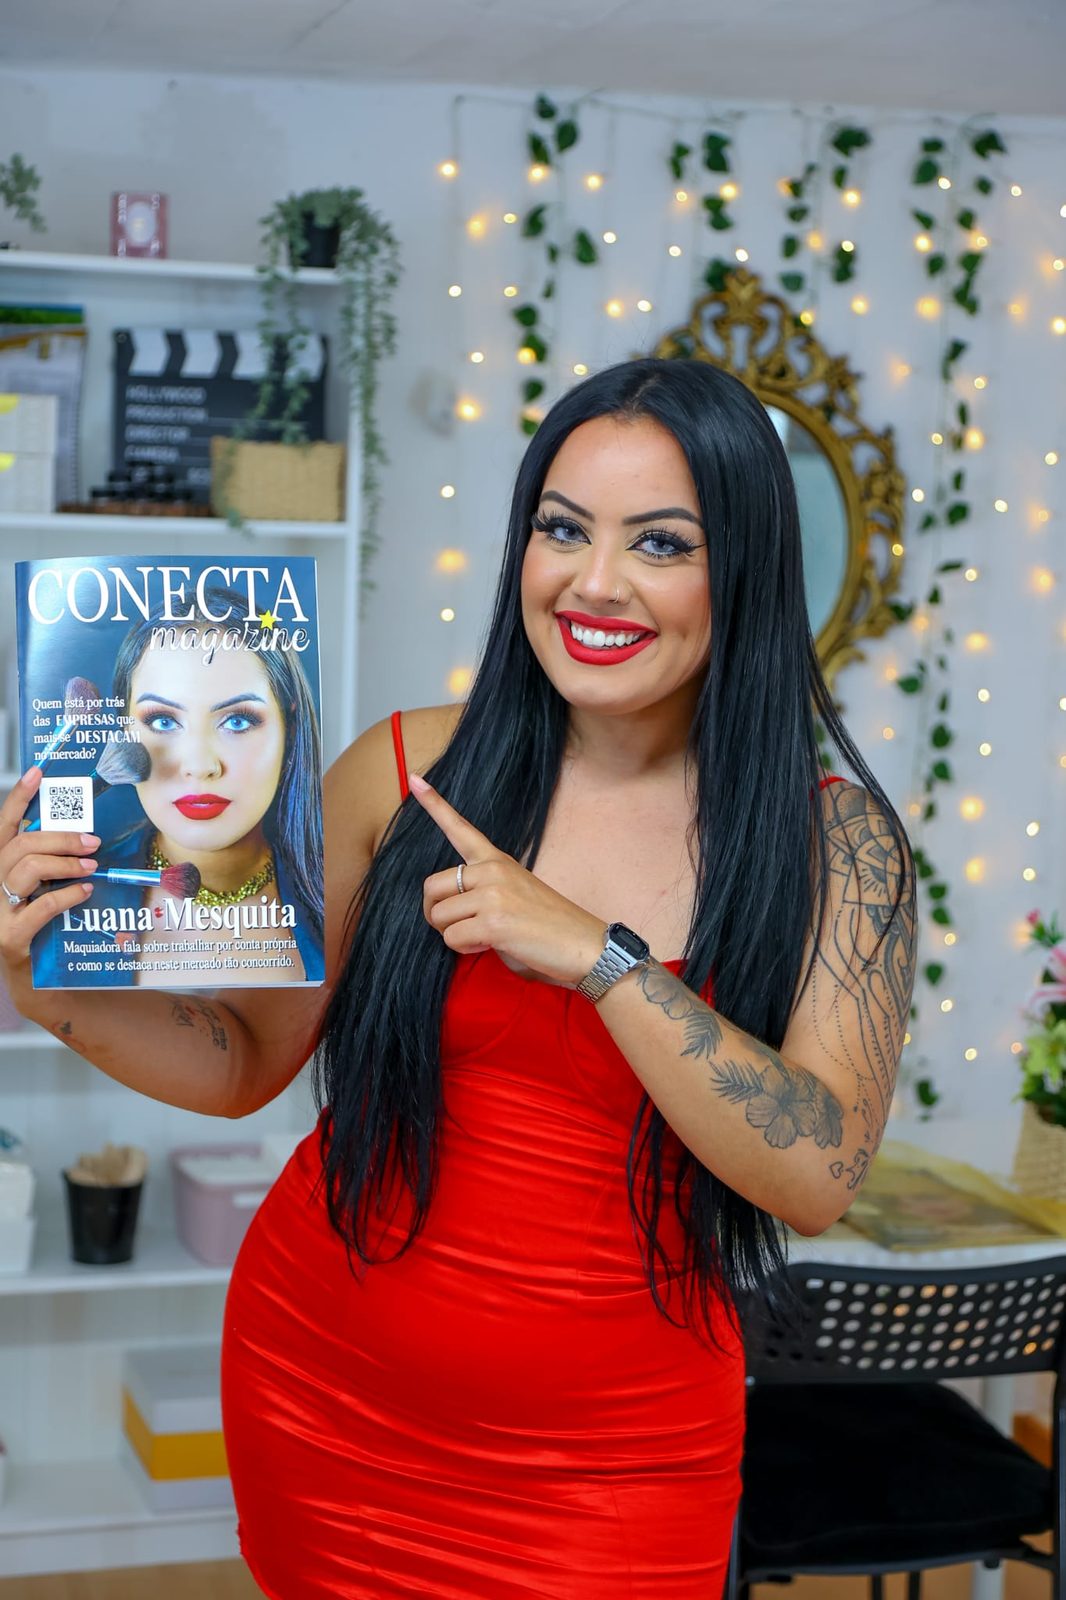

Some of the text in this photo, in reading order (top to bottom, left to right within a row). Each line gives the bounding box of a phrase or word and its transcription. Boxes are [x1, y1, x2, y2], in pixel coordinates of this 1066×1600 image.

[28, 566, 309, 624] CONECTA
[150, 622, 310, 664] magazine
[32, 696, 125, 711] Quem está por trás
[33, 713, 135, 727] das EMPRESAS que
[34, 730, 141, 744] mais se DESTACAM
[34, 747, 97, 761] no mercado?
[61, 895, 297, 939] Luana Mesquita
[64, 937, 297, 957] Maquiadora fala sobre trabalhar por conta própria
[67, 955, 295, 971] e como se destaca neste mercado tão concorrido.
